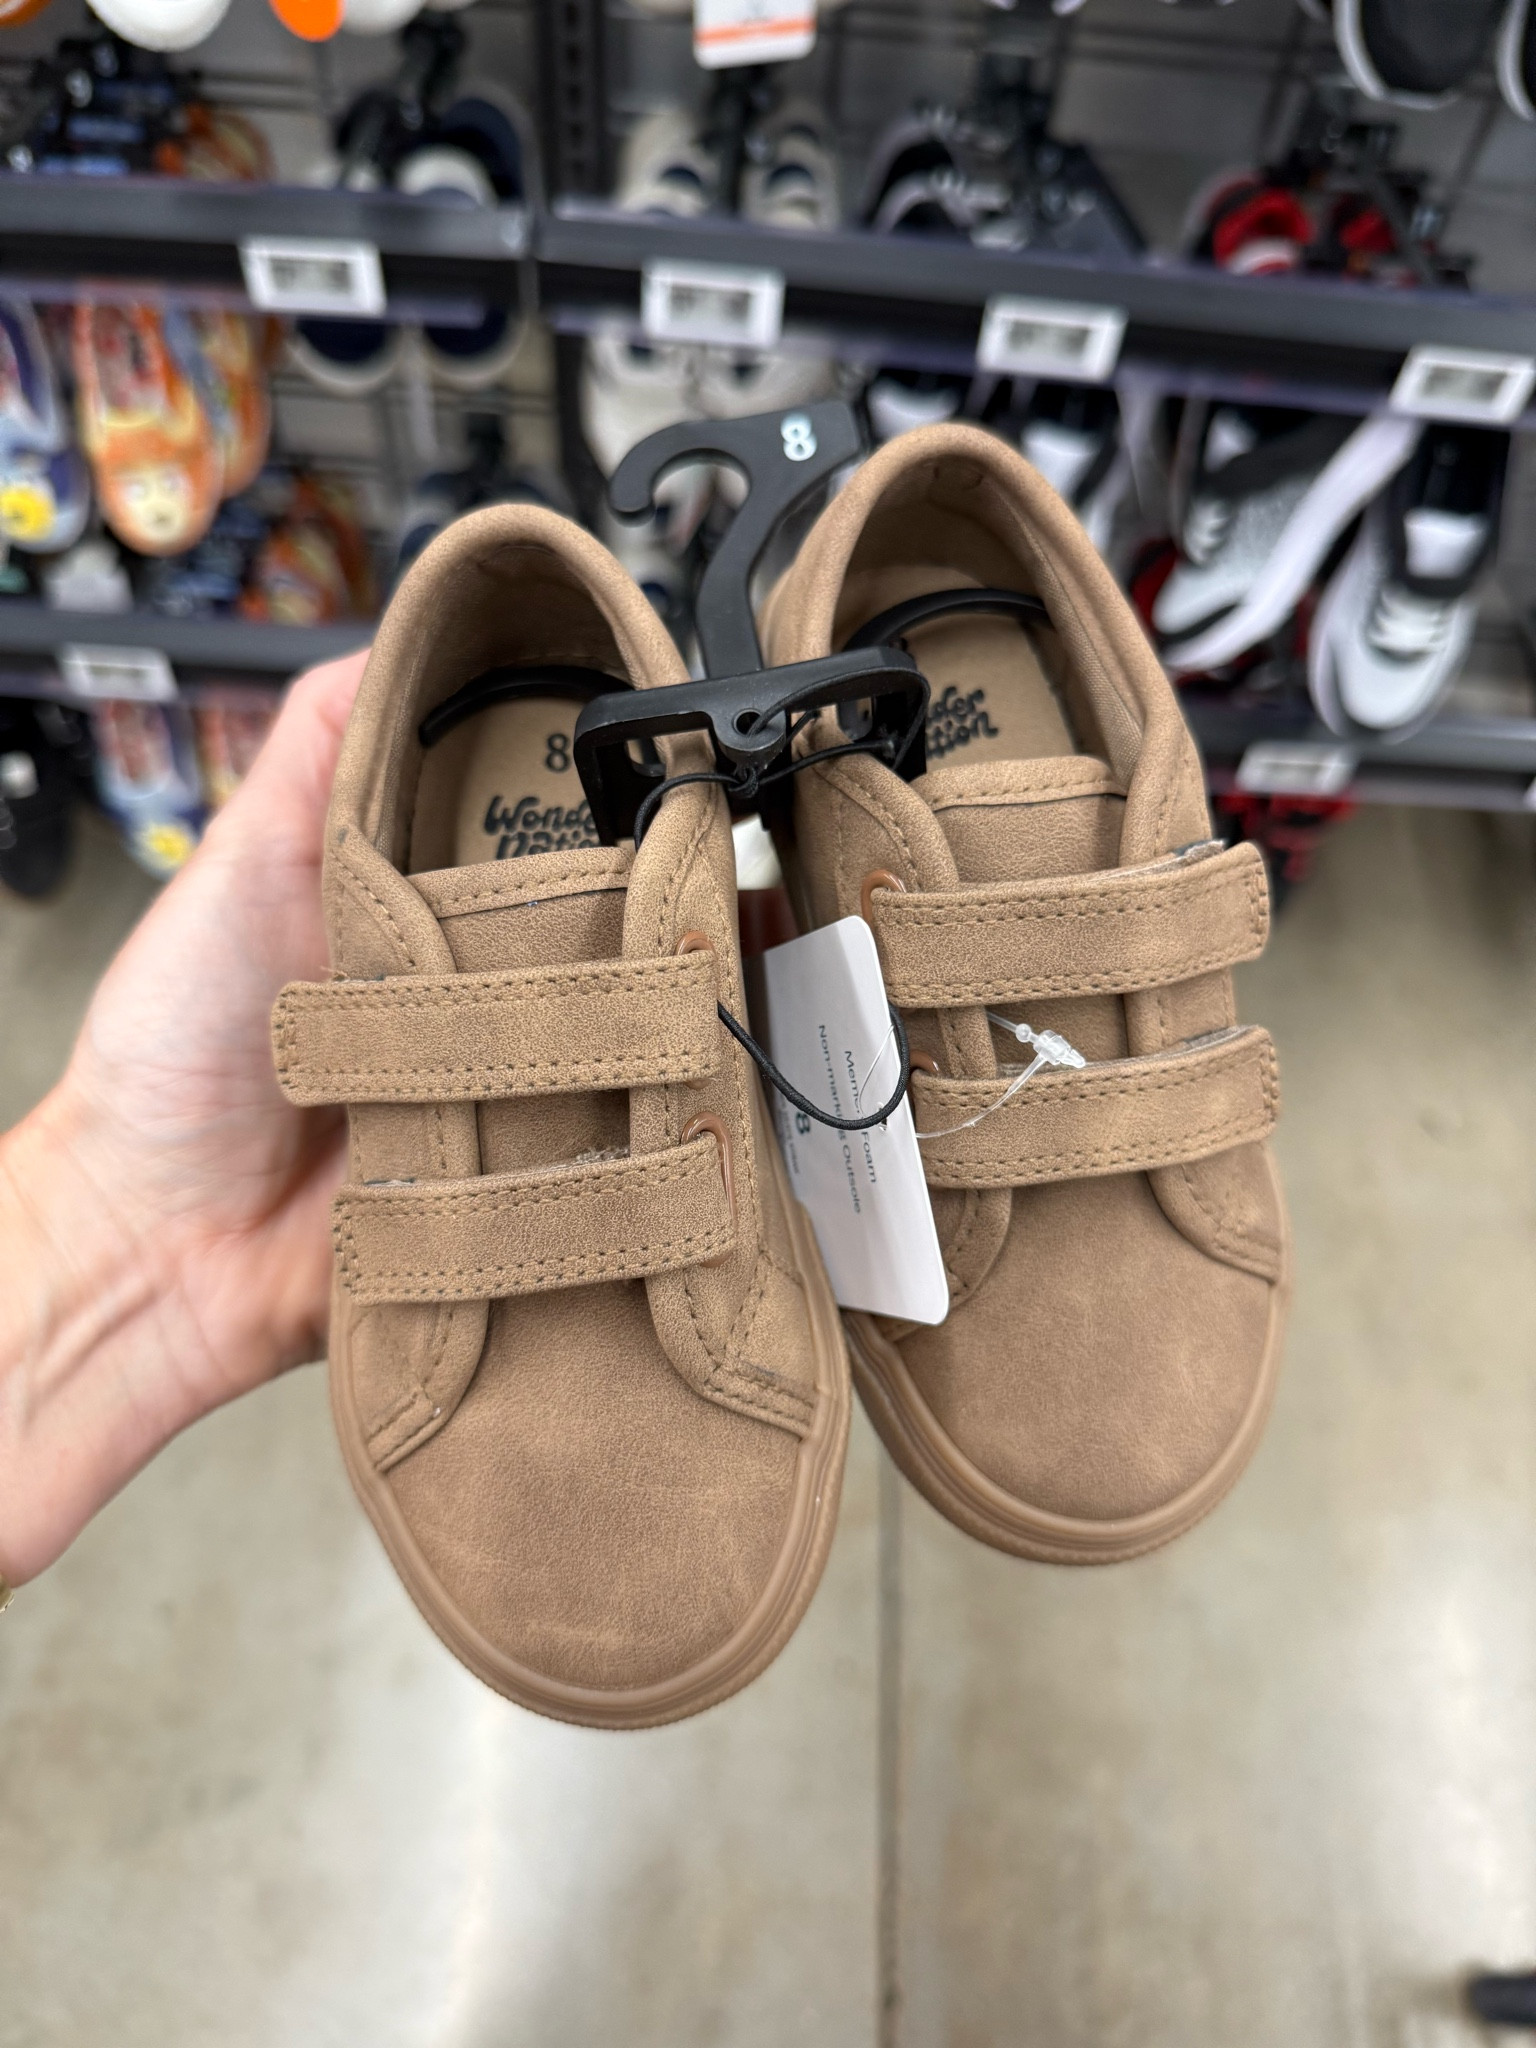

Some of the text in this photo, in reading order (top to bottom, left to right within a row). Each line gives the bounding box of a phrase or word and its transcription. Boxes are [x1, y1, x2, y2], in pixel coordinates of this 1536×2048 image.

[781, 412, 817, 462] 8
[930, 686, 985, 724] der
[544, 733, 571, 773] 8
[927, 711, 998, 758] tion
[484, 795, 597, 835] Wonde
[796, 1112, 811, 1135] 8
[818, 1024, 861, 1214] Non-markig Outsole
[844, 1050, 877, 1183] Memo Foam
